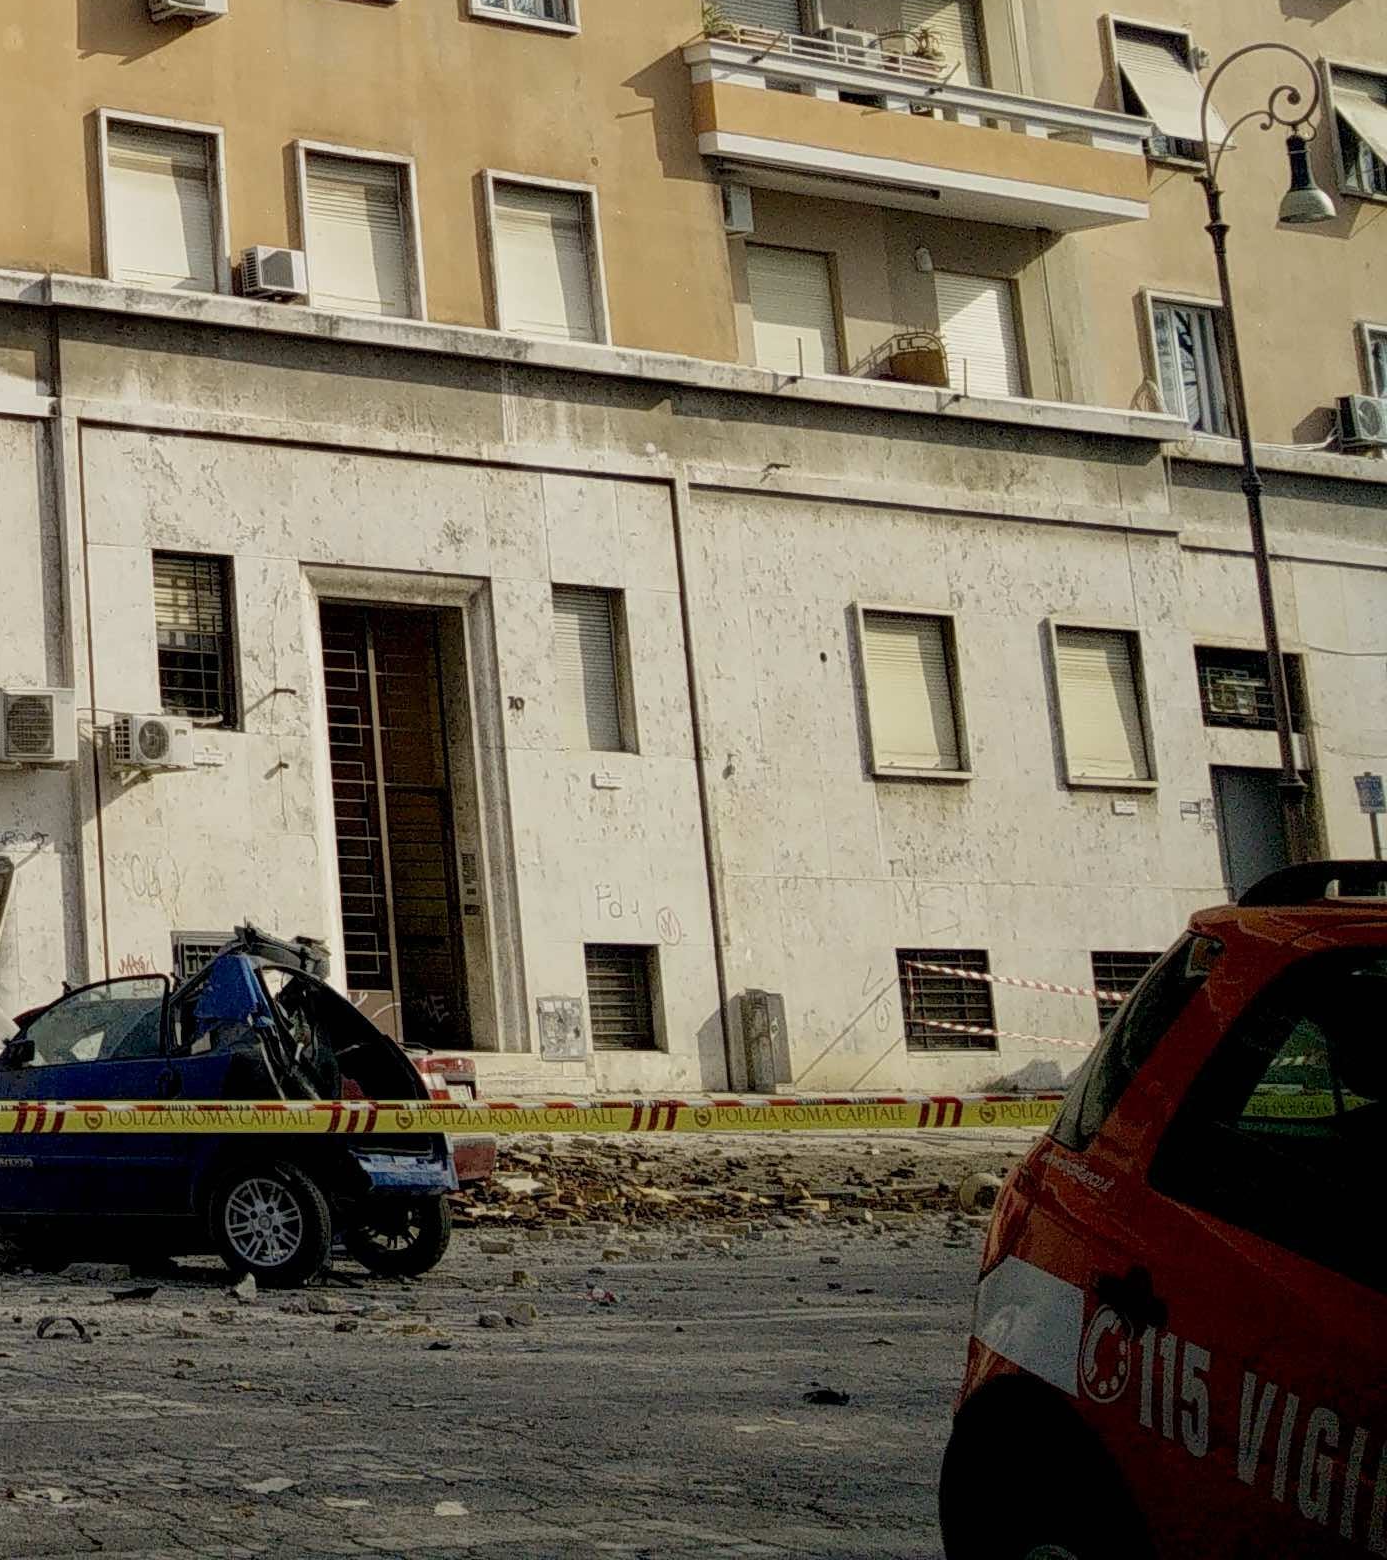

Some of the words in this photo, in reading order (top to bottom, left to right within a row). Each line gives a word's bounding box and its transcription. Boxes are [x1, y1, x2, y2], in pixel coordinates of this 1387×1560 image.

[109, 1109, 176, 1127] POLIZIA
[180, 1109, 233, 1127] ROMA
[239, 1109, 316, 1127] CAPITALE
[419, 1108, 484, 1126] POLIZIA
[488, 1108, 541, 1126] ROMA
[546, 1108, 618, 1126] CAPITALE
[716, 1105, 779, 1124] POLIZIA
[784, 1105, 832, 1124] ROMA
[836, 1104, 907, 1123] CAPITALE
[1138, 1325, 1212, 1458] 115
